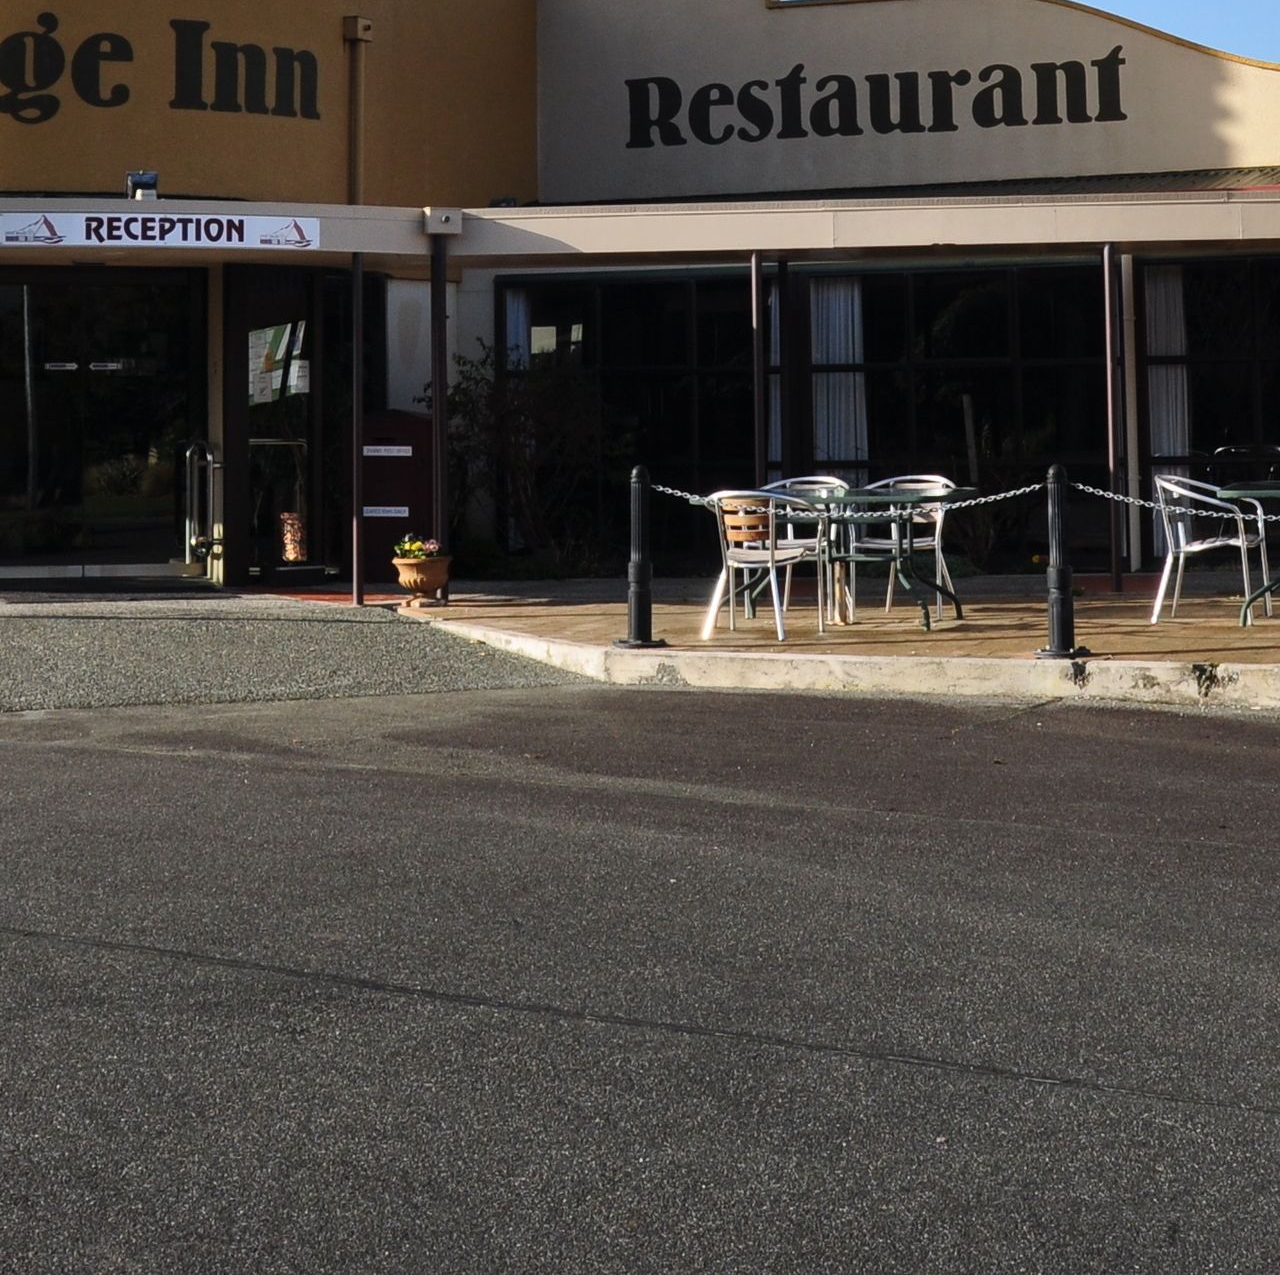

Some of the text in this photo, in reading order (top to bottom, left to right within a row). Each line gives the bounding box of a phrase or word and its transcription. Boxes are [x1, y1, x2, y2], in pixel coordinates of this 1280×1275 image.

[168, 19, 320, 120] Inn
[624, 45, 1128, 149] Restaurant
[83, 215, 246, 245] RECEPTION
